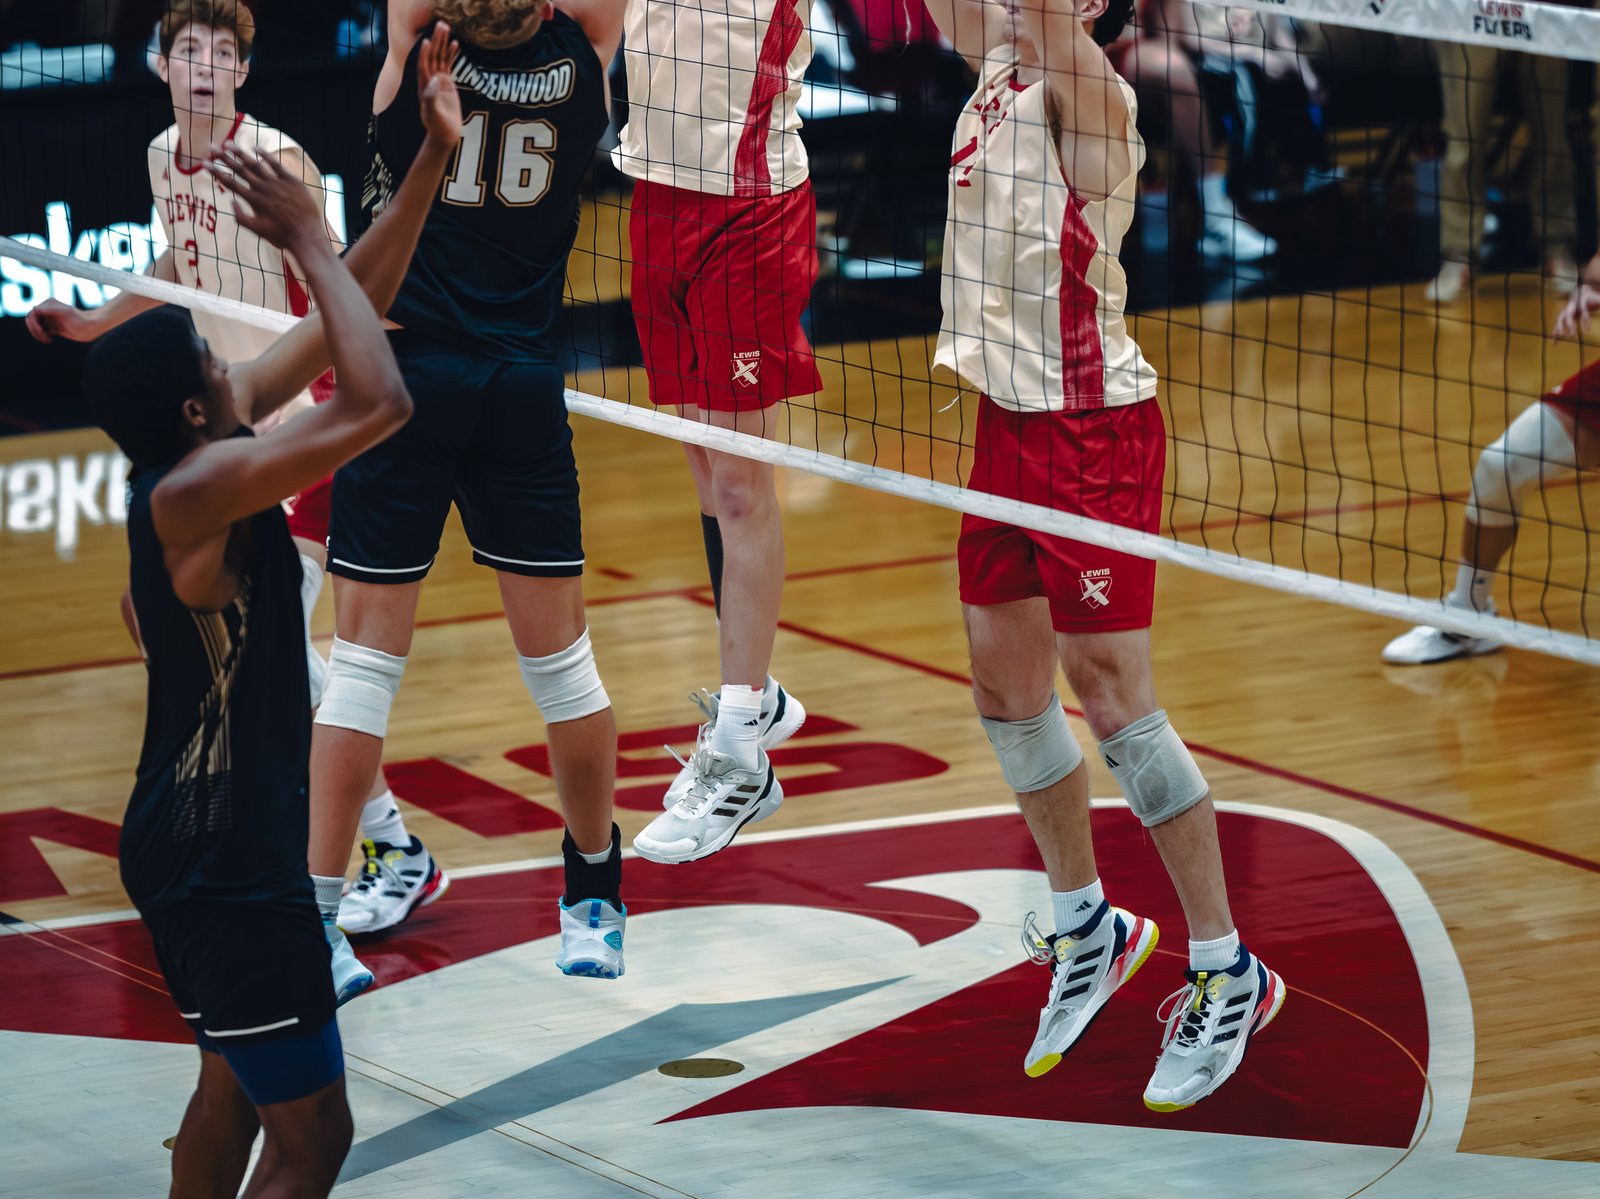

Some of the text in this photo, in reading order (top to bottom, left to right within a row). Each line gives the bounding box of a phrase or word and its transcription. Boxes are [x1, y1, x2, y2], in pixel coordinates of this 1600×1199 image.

[1472, 15, 1534, 41] FLYERS
[441, 111, 558, 208] 16
[165, 194, 218, 234] LEWIS
[733, 350, 760, 359] LEWIS
[1080, 568, 1111, 578] LEWIS
